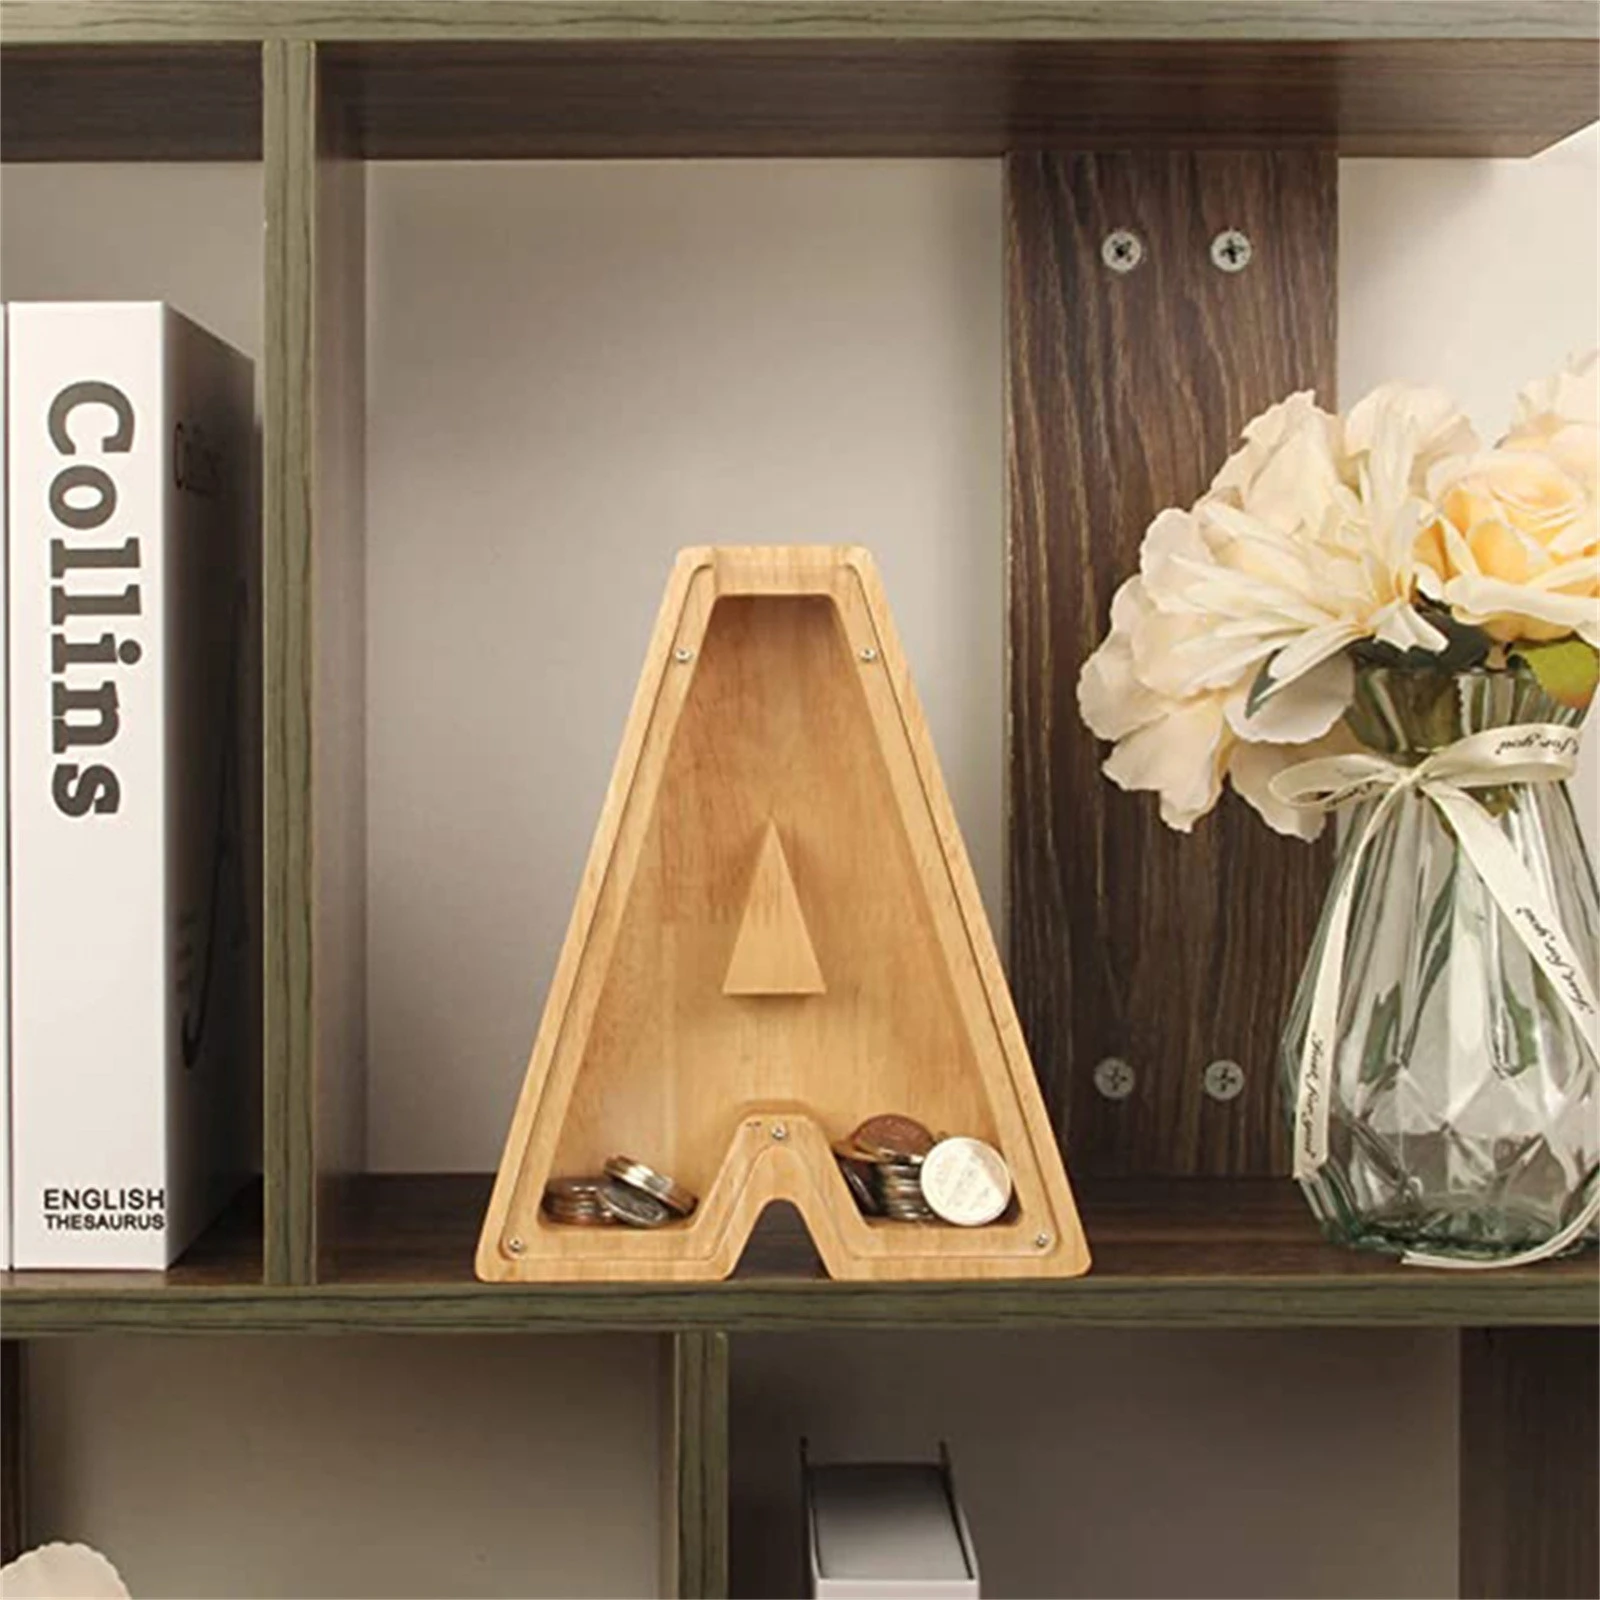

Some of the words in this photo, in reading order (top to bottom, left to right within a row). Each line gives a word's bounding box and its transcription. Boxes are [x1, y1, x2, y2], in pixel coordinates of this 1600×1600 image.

[47, 379, 142, 817] Collins
[43, 1188, 165, 1211] ENGLISH
[43, 1213, 166, 1231] THESAURUS
